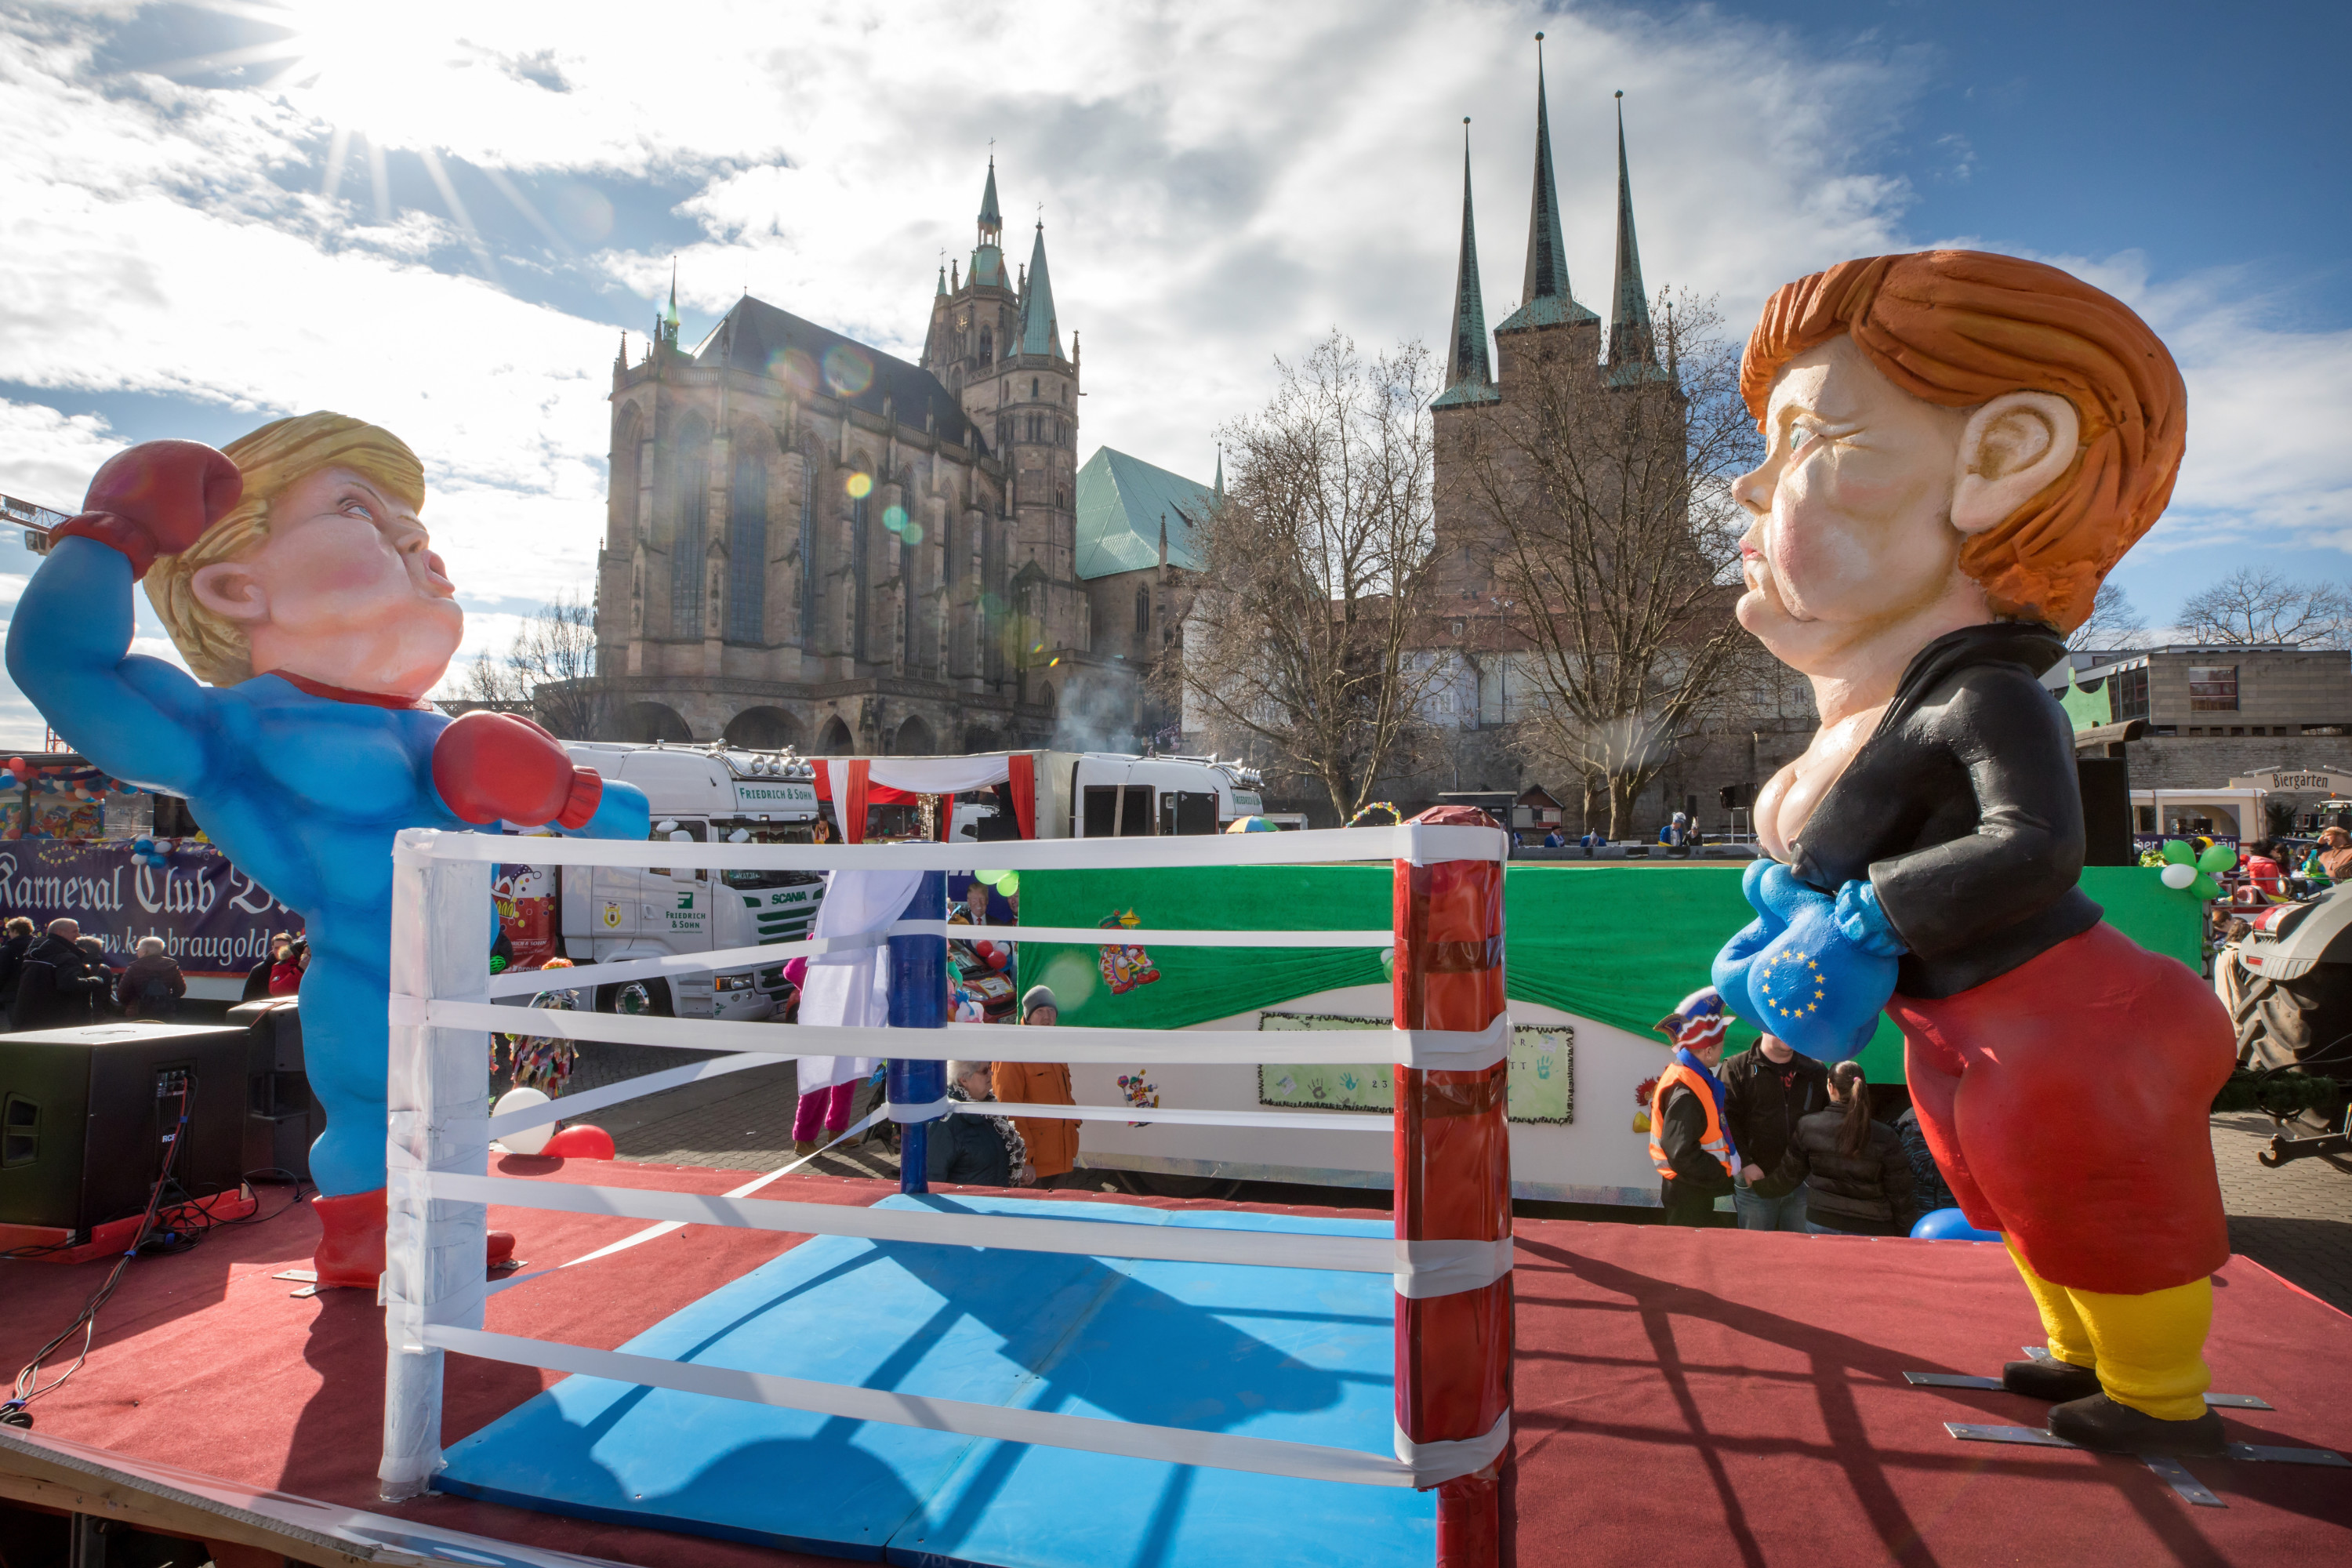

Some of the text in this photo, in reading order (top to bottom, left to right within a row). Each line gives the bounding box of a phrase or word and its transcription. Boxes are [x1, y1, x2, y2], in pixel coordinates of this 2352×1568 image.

[2273, 774, 2328, 789] Biergarten
[739, 787, 812, 800] FRIEDRICH & SOHN
[0, 852, 124, 912] Karneval
[135, 862, 216, 914] Club
[771, 891, 808, 905] SCANIA
[162, 1134, 176, 1143] RCF
